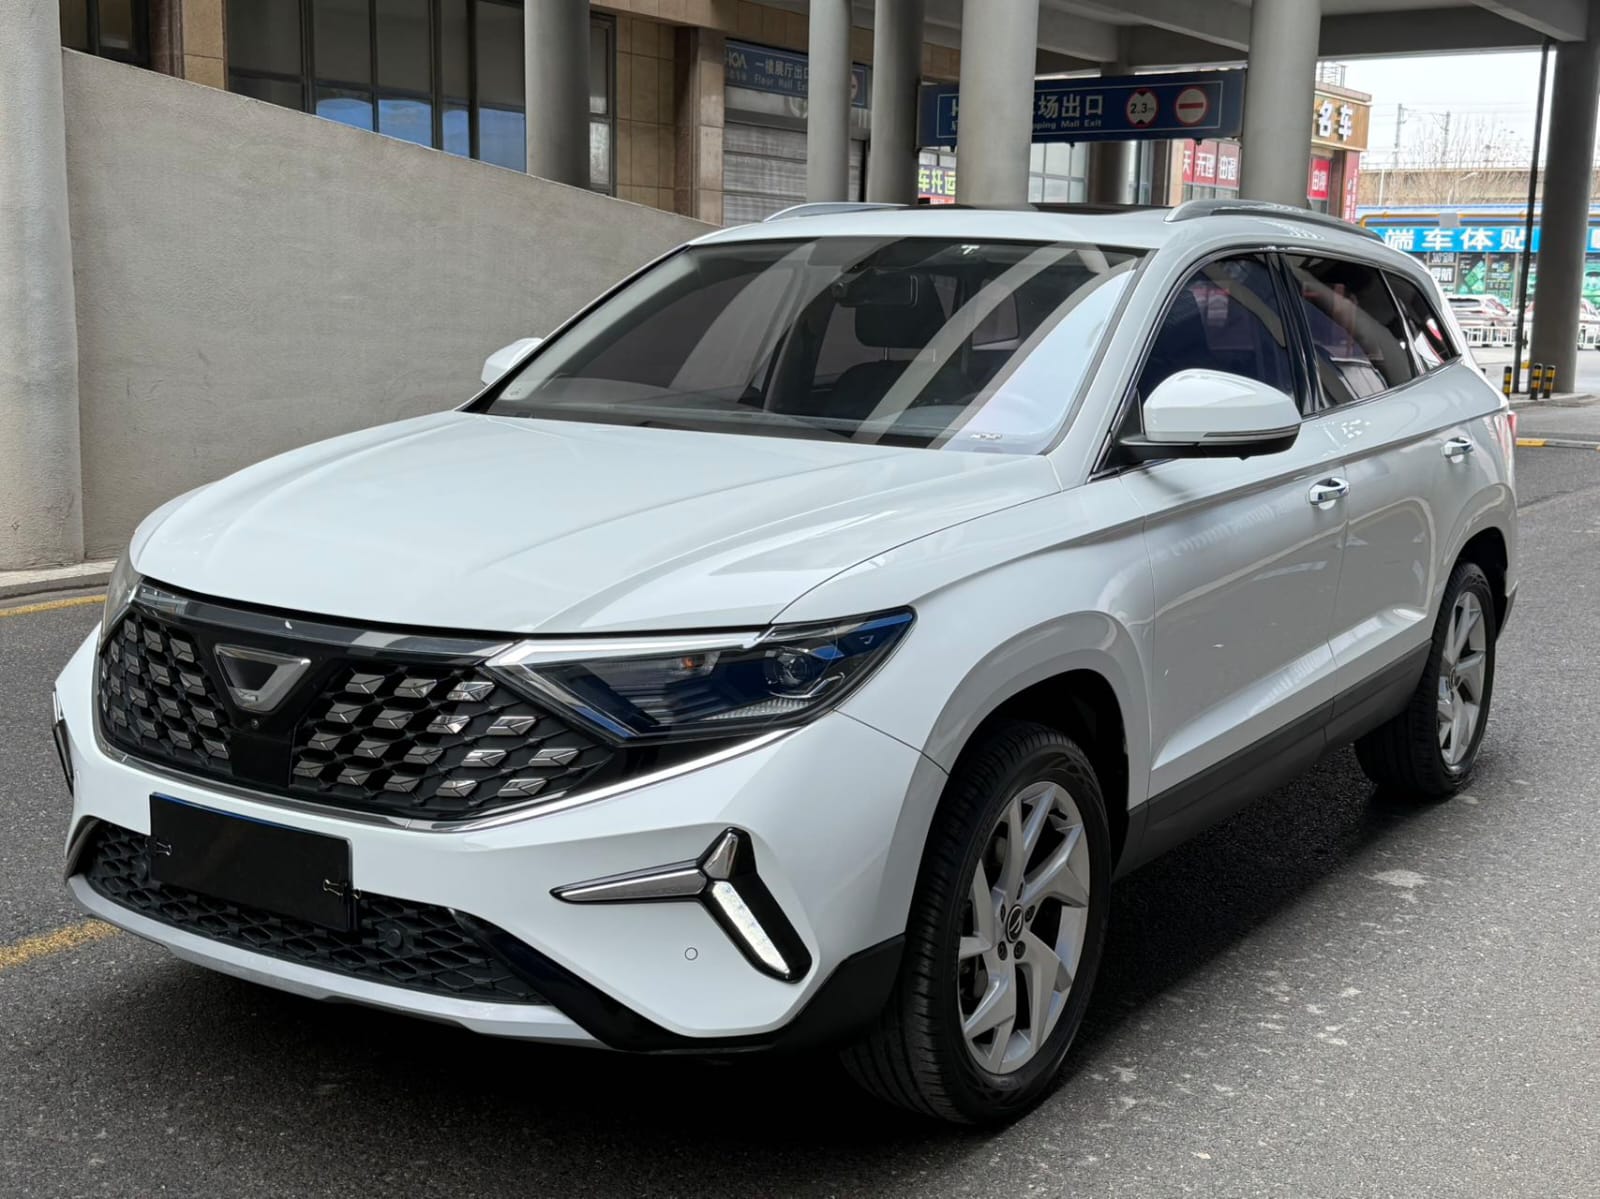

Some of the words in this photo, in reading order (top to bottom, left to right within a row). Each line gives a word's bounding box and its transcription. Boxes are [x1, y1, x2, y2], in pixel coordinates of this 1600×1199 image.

[1034, 93, 1104, 118] 场出口
[1084, 119, 1102, 128] Exit
[1318, 100, 1353, 142] 名车
[1384, 228, 1526, 251] 端车体贴
